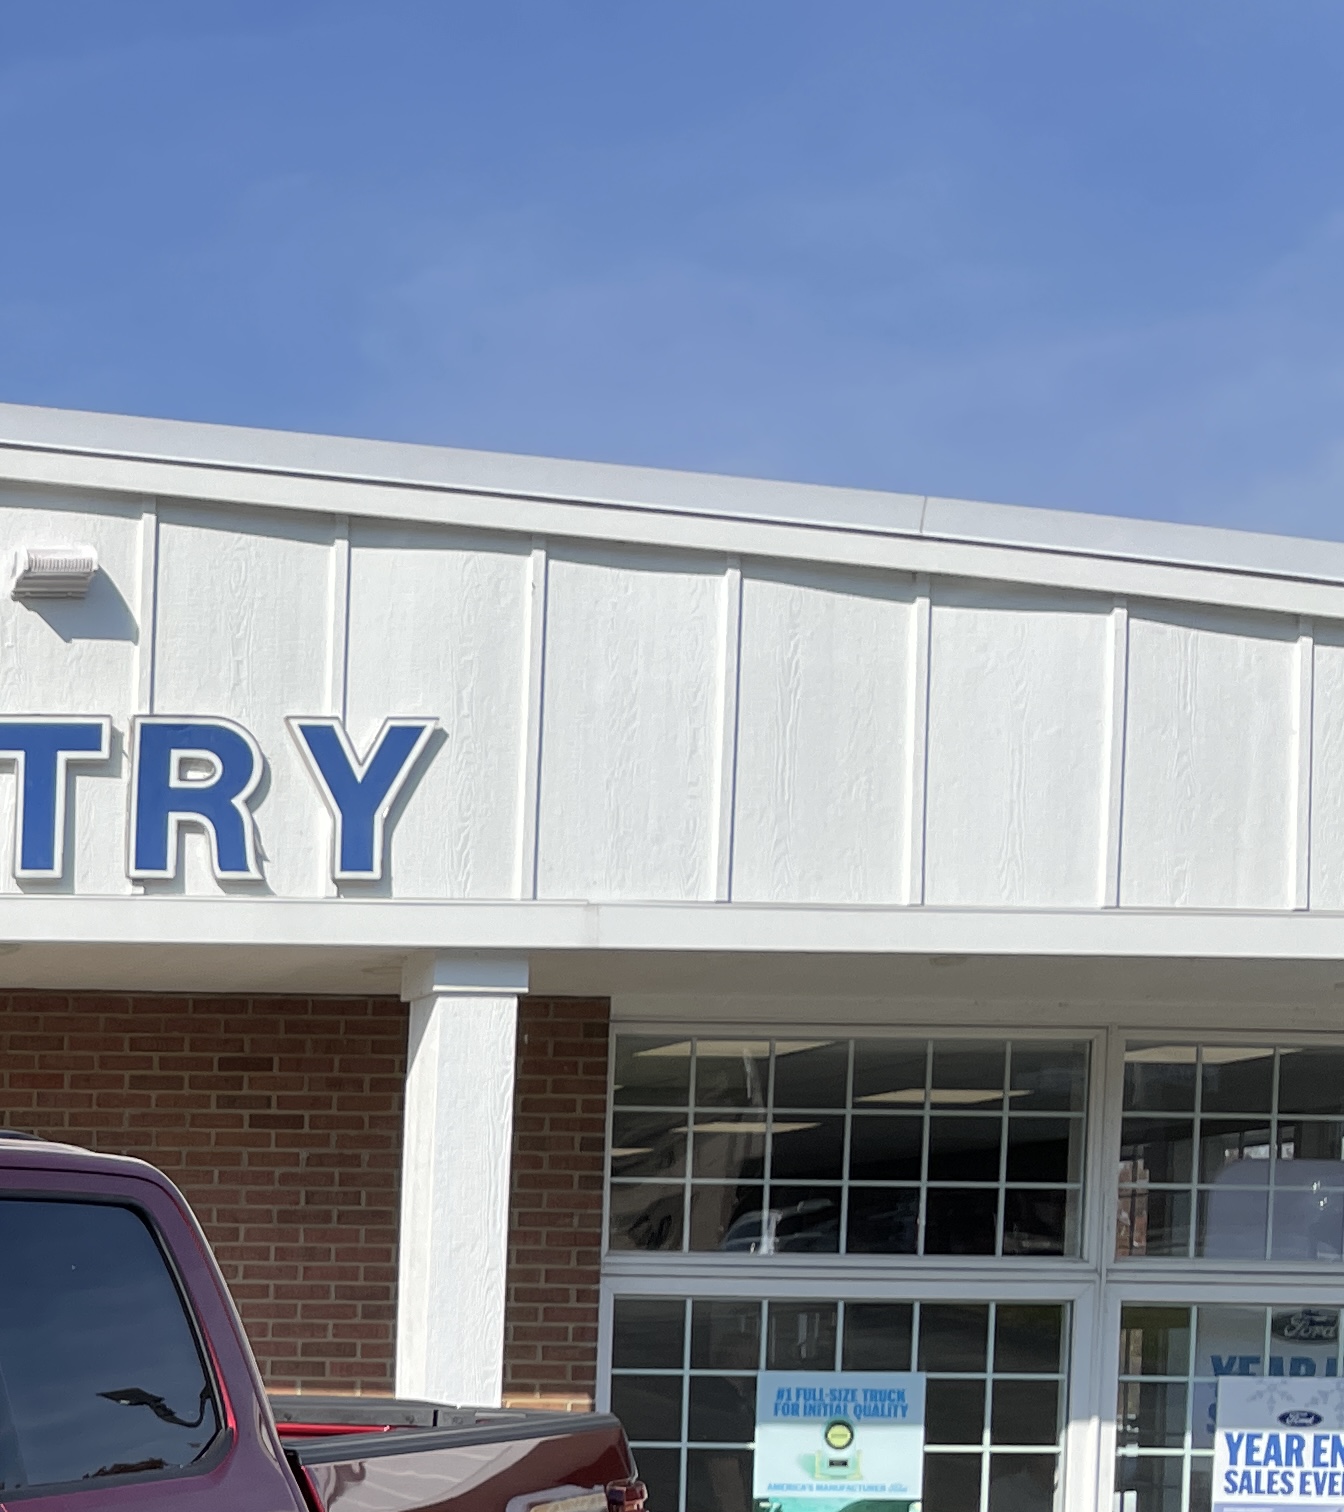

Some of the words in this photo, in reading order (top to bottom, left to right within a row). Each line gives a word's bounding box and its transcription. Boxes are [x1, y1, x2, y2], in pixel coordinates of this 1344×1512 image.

[776, 1387, 792, 1401] #1
[795, 1387, 858, 1402] FULL-SIZE
[862, 1388, 906, 1403] TRUCK
[773, 1402, 799, 1416] FOR
[803, 1403, 849, 1418] INITIAL
[853, 1404, 908, 1421] QUALITY
[1224, 1432, 1306, 1468] YEAR
[1223, 1470, 1295, 1496] SALES
[1299, 1471, 1344, 1497] EVE
